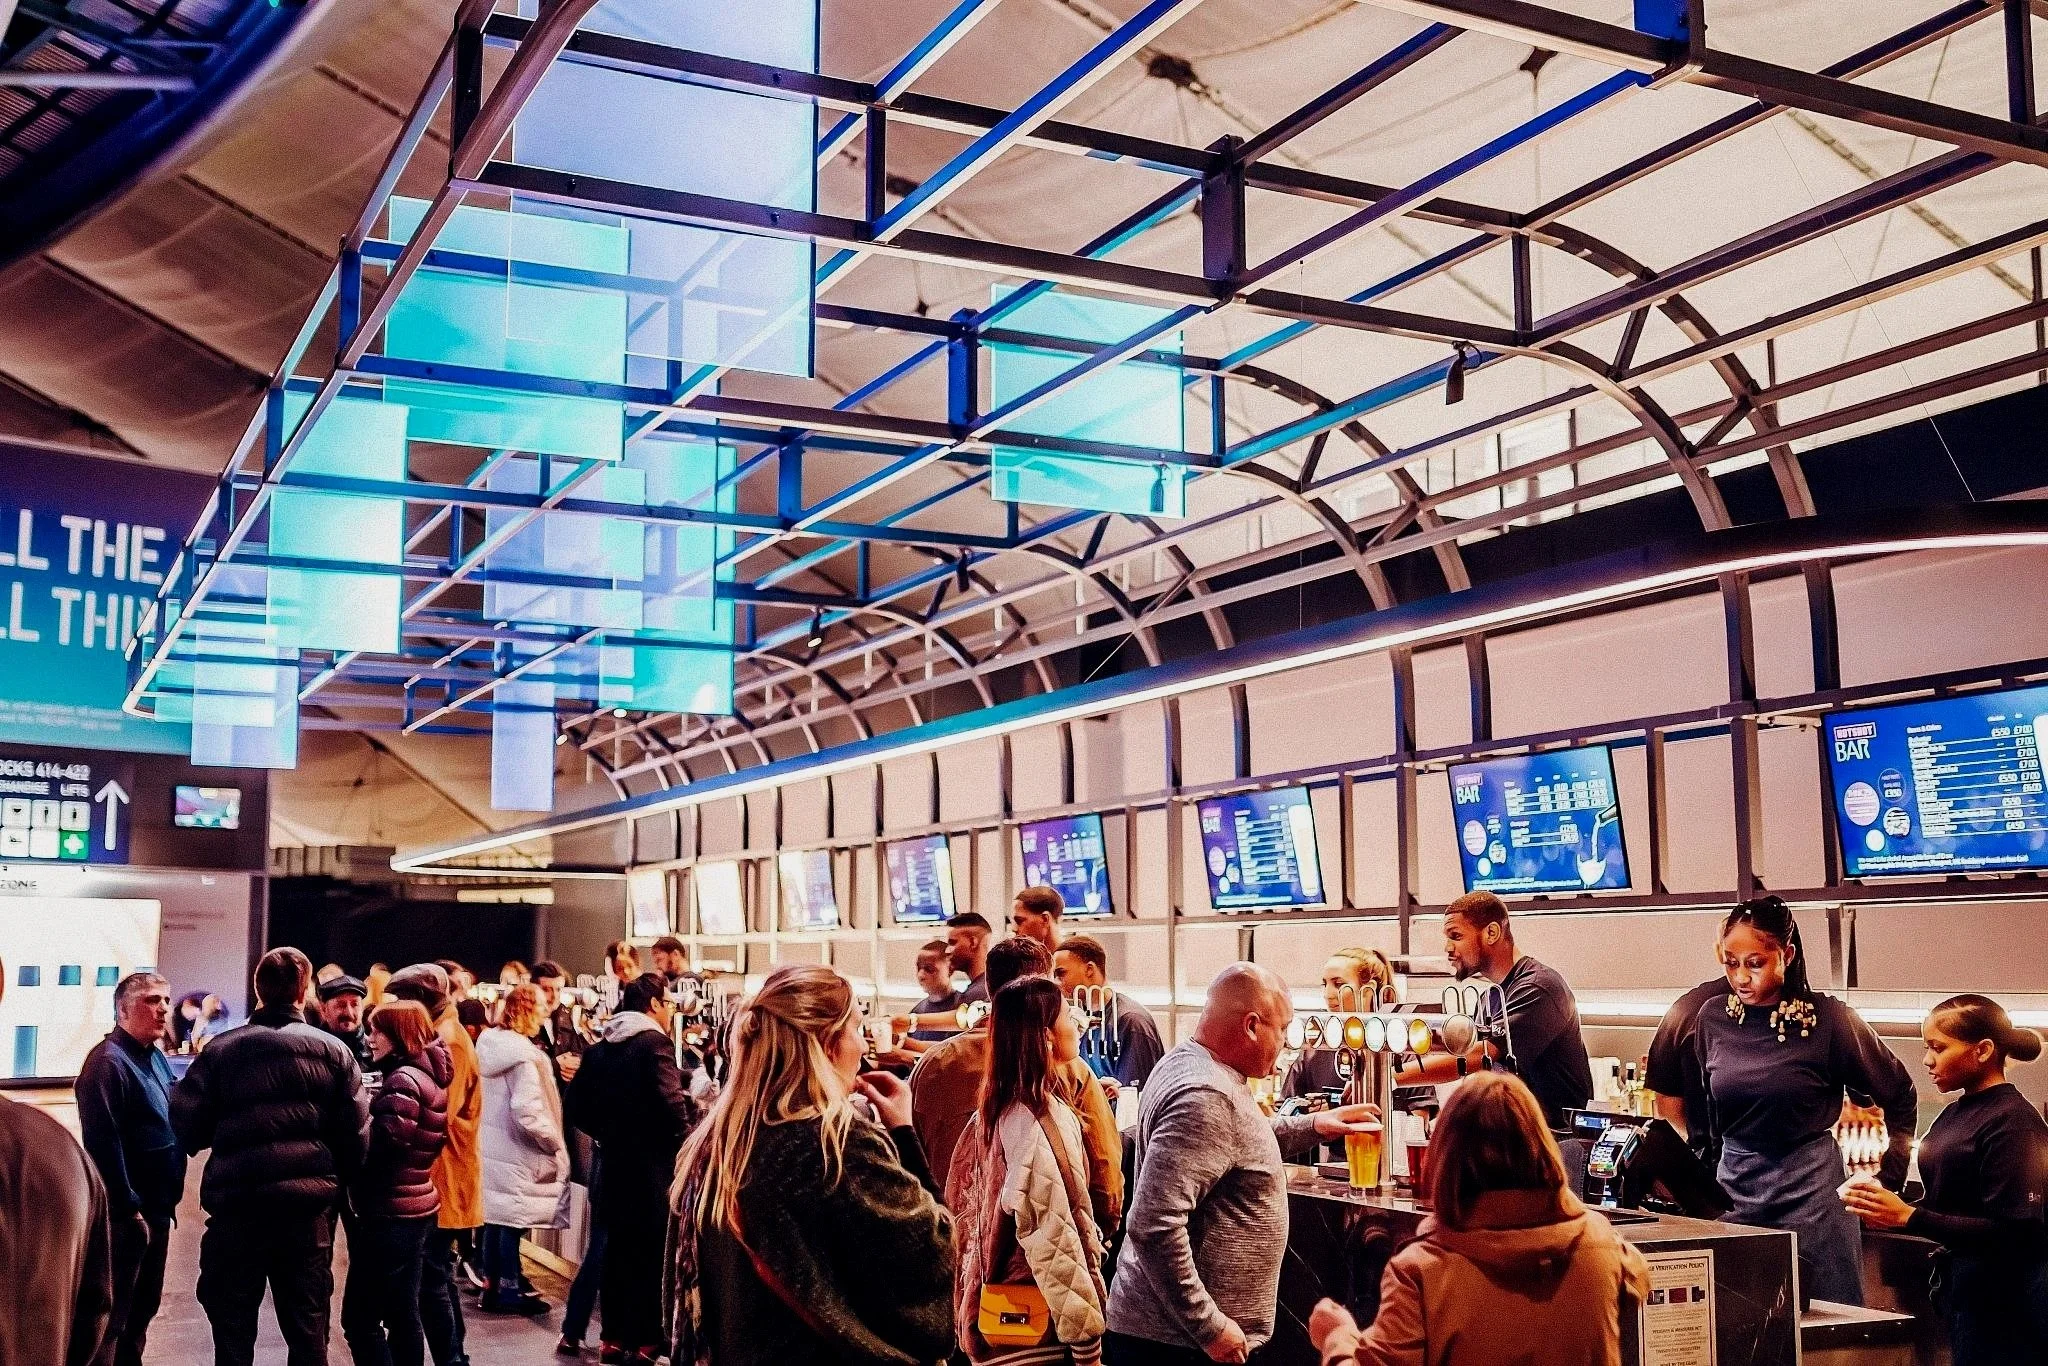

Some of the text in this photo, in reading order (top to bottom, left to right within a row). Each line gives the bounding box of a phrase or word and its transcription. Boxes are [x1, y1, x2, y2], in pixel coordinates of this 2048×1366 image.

[61, 515, 166, 585] THE
[0, 582, 40, 642] L
[1835, 739, 1870, 762] BAR
[36, 762, 91, 781] 414-422
[1456, 785, 1480, 804] BAR
